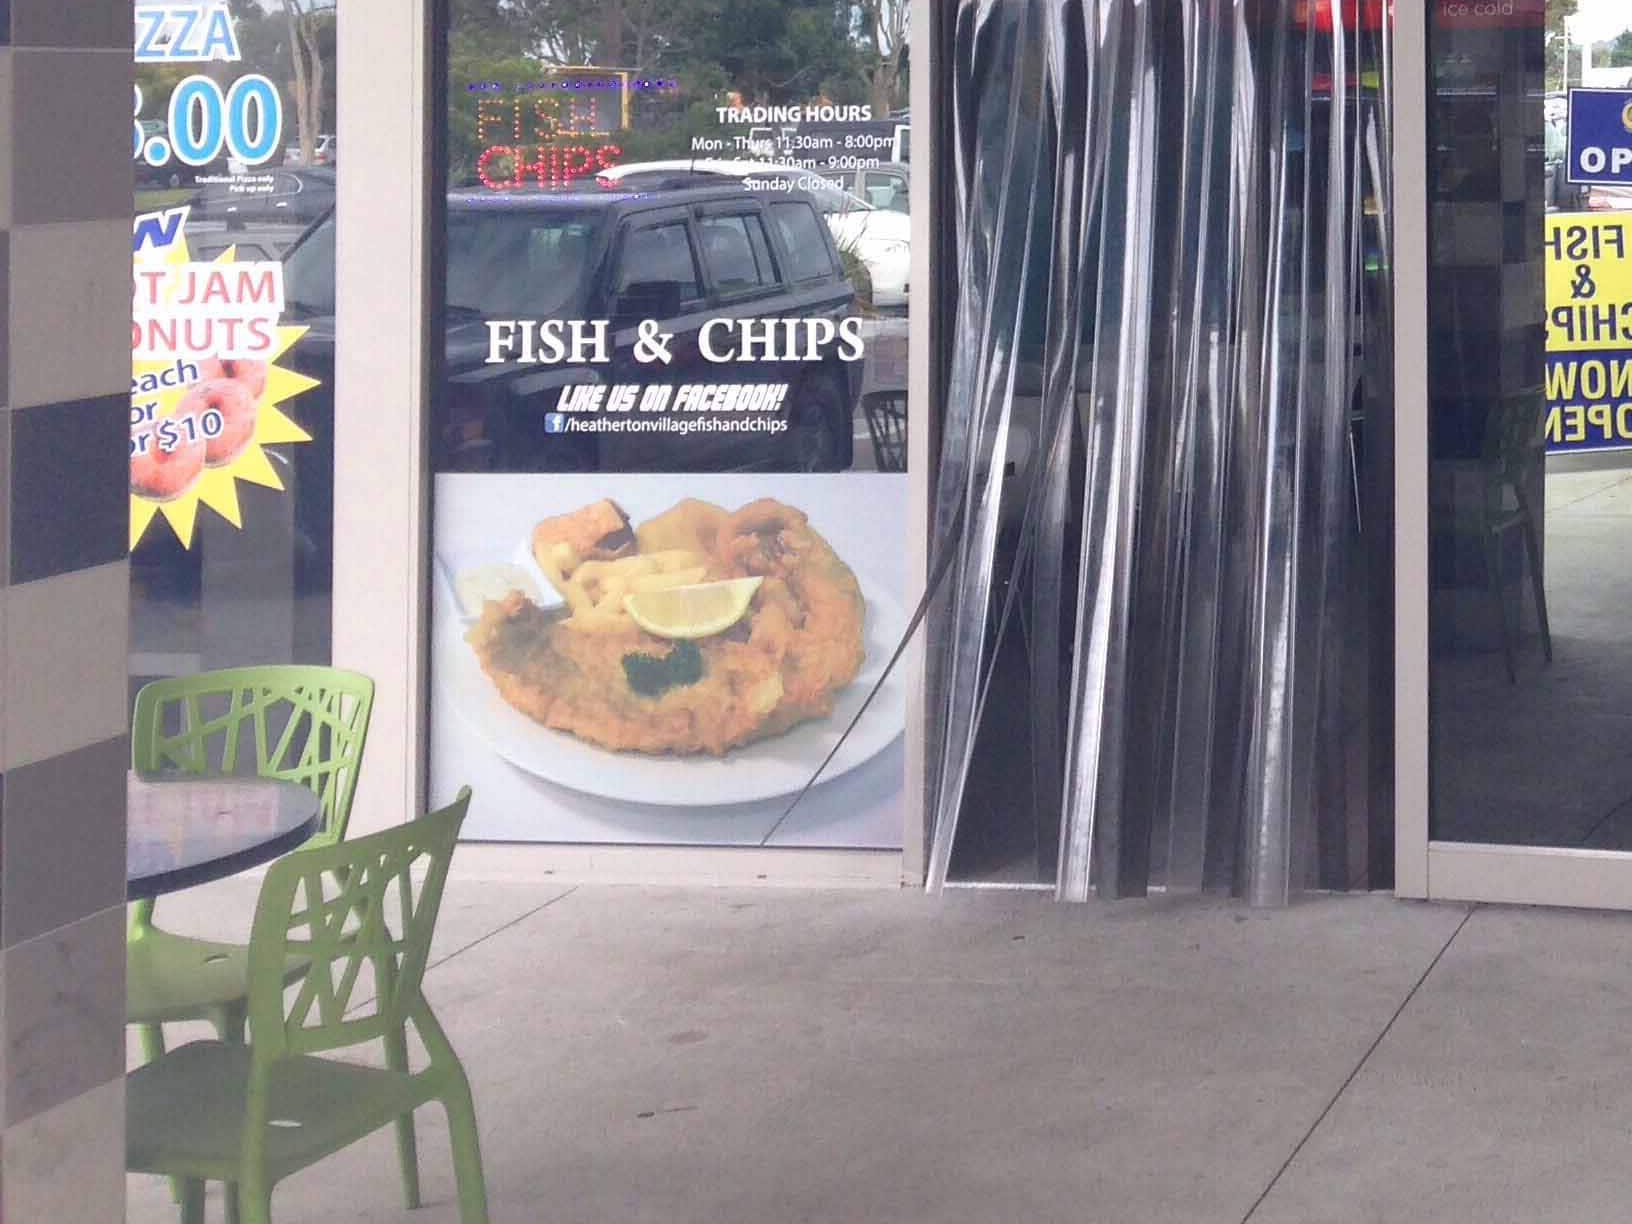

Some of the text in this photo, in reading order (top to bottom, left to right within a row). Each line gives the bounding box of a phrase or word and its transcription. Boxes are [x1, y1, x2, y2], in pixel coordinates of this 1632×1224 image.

[1474, 0, 1513, 16] cold
[134, 76, 281, 166] .00
[478, 97, 597, 140] FISH
[715, 105, 872, 123] TRADING HOURS
[691, 136, 723, 151] Mon
[844, 134, 894, 152] 8:00pm
[478, 145, 623, 190] CHIPS
[827, 155, 880, 172] 9:00pm
[742, 176, 844, 193] Sunday Closed
[133, 270, 276, 305] T JAM
[485, 316, 865, 365] FISH & CHIPS
[556, 383, 789, 413] LIKE US ON FACEBOOK!
[159, 411, 222, 448] $10
[564, 416, 788, 435] /heathertonvillagefishandchips
